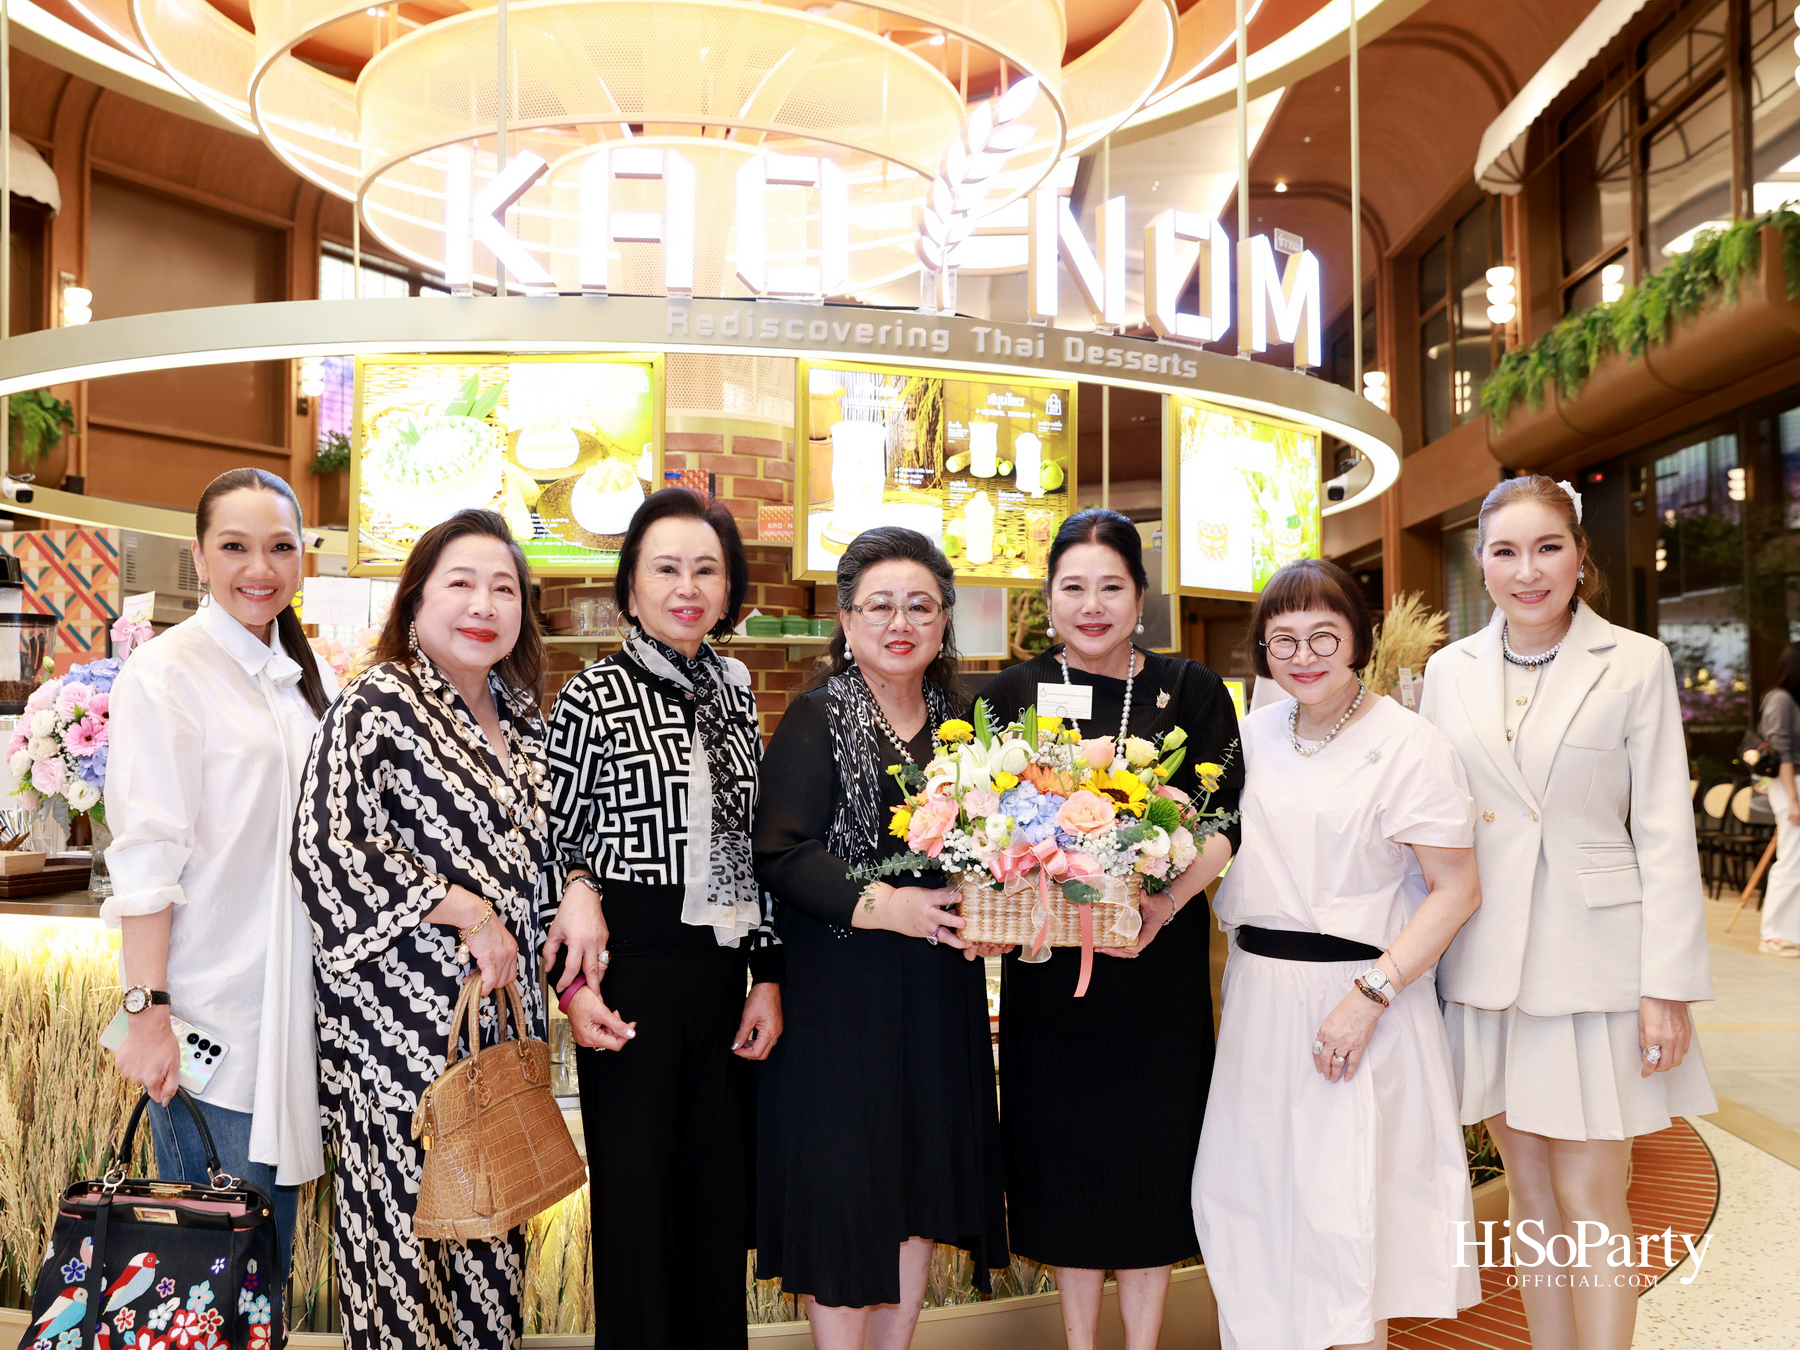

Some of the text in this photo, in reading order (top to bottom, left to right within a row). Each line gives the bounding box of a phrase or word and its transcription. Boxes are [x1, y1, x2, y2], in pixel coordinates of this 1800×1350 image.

[445, 144, 1322, 368] KAO NOM
[666, 305, 1198, 378] Rediscovering Thai Desserts
